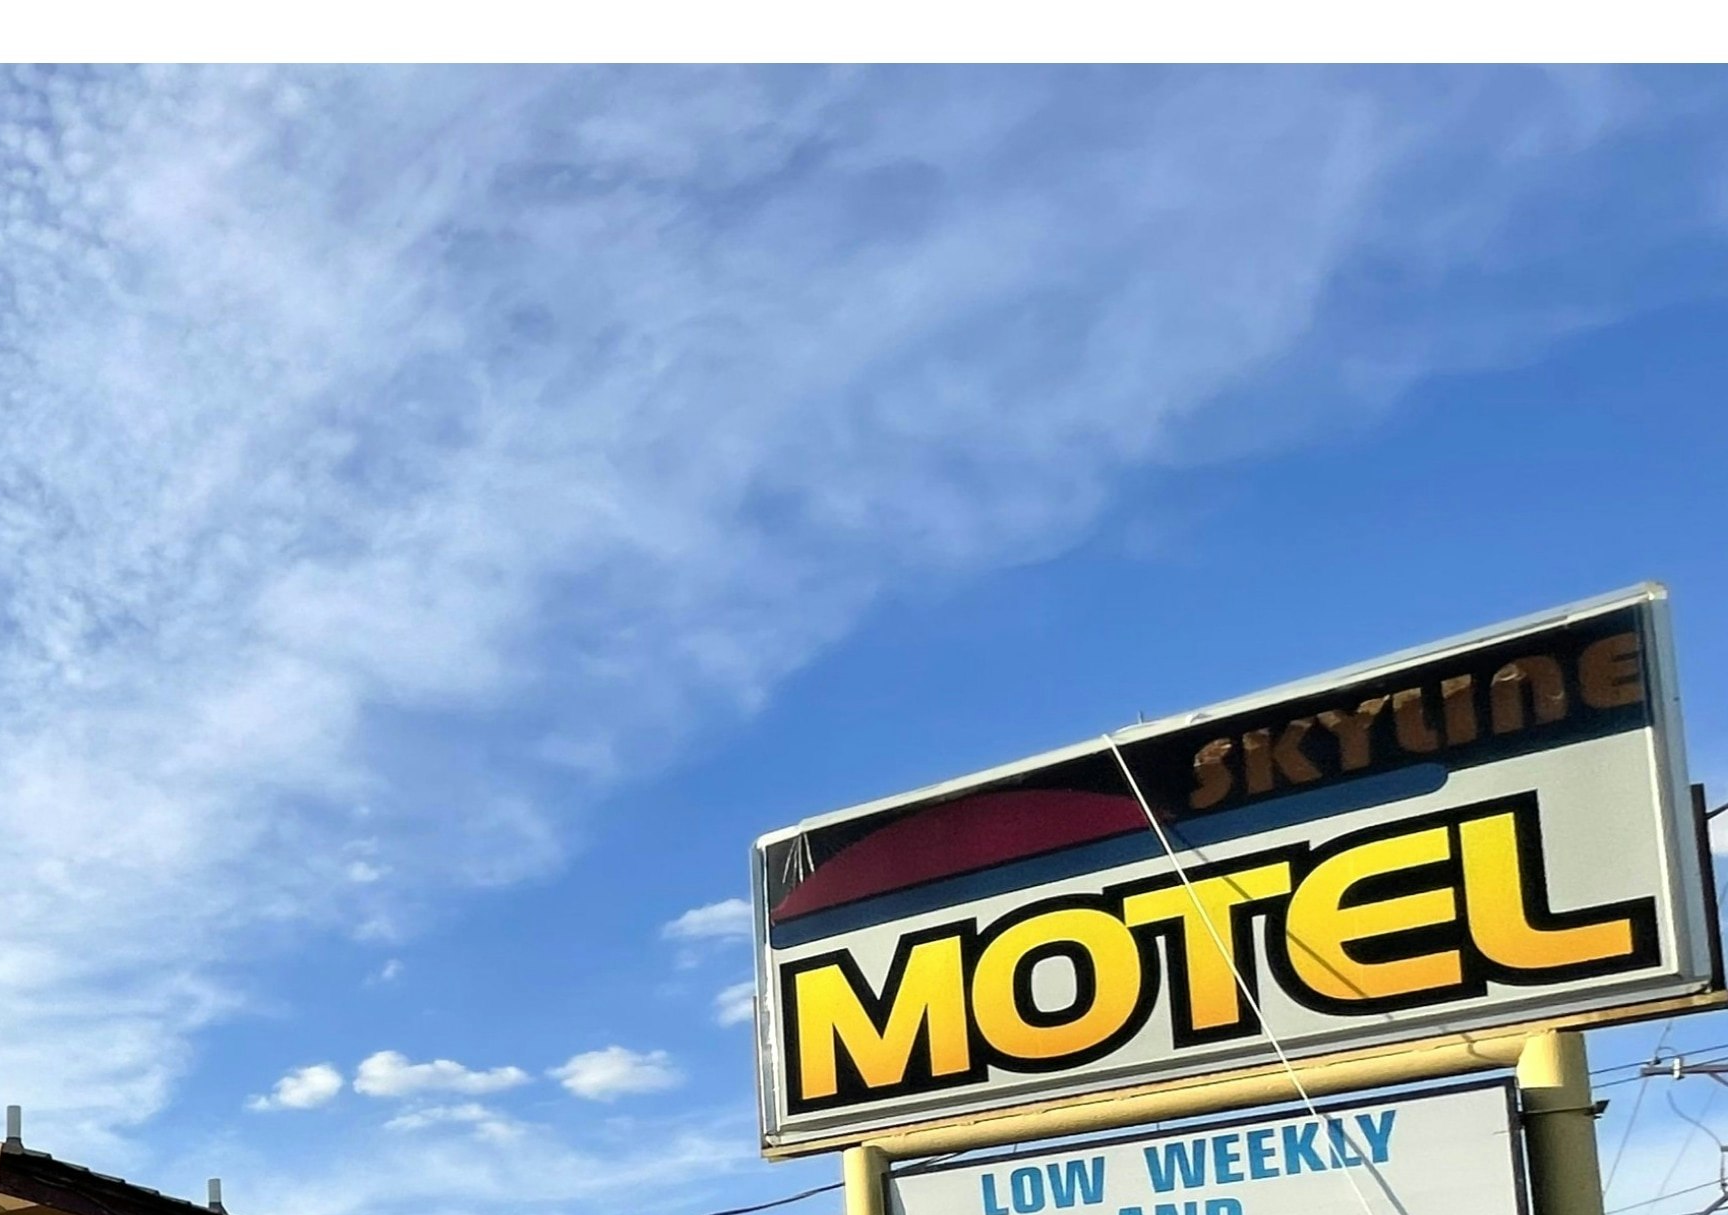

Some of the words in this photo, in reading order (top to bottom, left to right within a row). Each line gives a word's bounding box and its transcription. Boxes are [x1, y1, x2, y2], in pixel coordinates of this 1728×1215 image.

[1189, 632, 1644, 809] SKYLINE
[782, 791, 1659, 1114] MOTEL
[1145, 1111, 1396, 1193] WEEKLY
